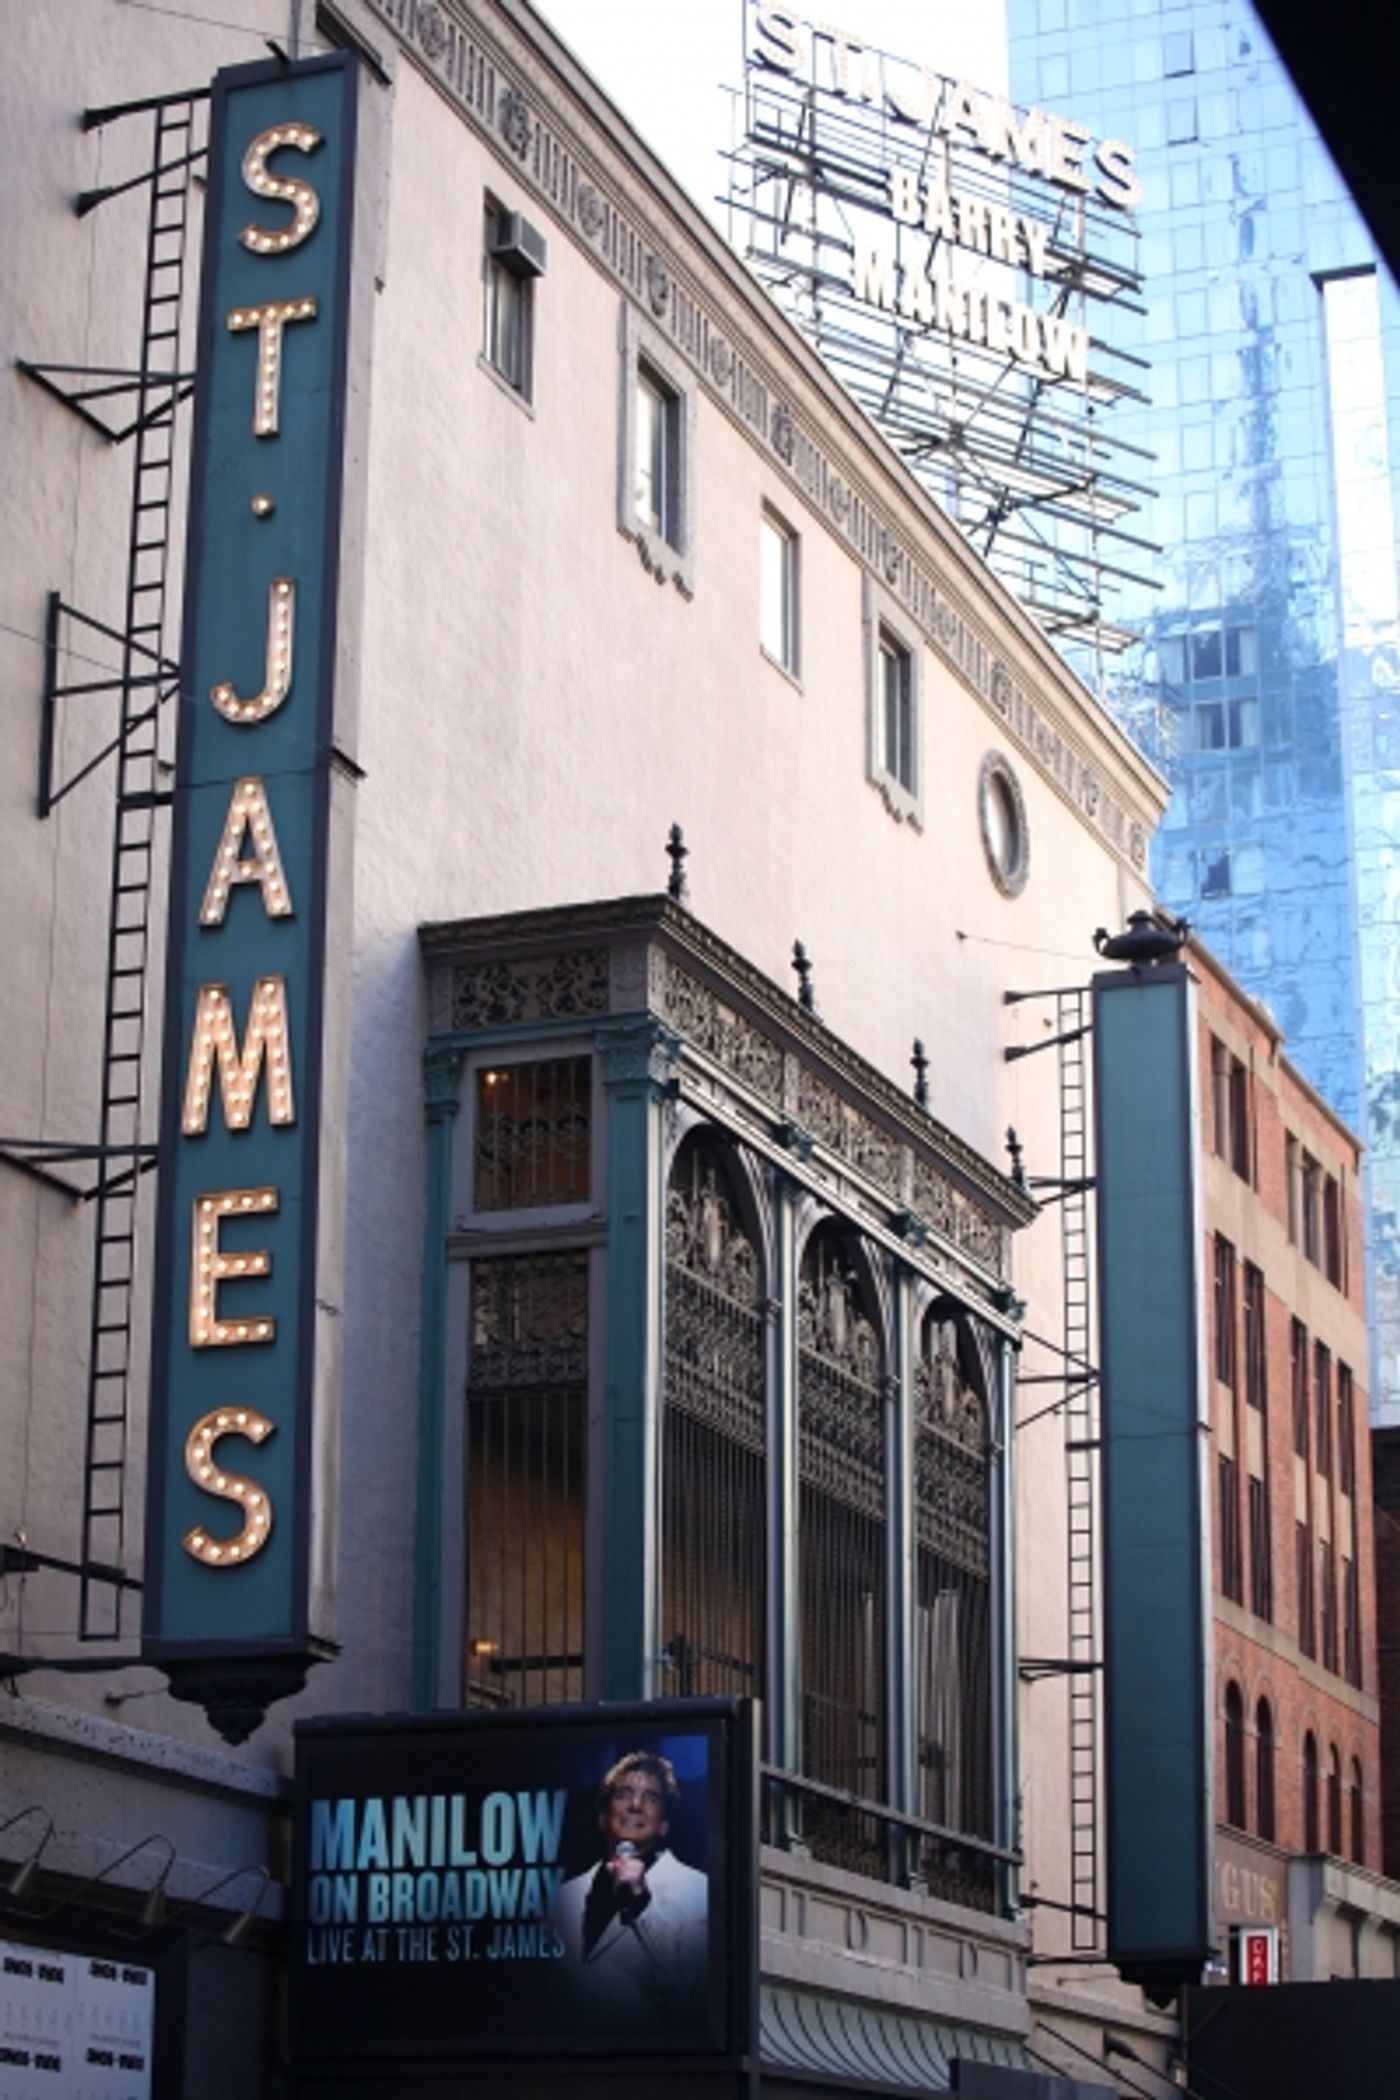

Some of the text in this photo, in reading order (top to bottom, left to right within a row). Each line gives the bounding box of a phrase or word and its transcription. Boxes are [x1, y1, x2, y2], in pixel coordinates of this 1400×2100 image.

[883, 64, 1143, 214] JAMES
[889, 168, 1048, 277] BARRY
[853, 240, 1089, 383] MANILOW
[180, 577, 298, 1567] JAMES
[309, 1789, 568, 1870] MANILOW
[307, 1922, 566, 1966] LIVE AT THE ST. JAMES
[308, 1866, 566, 1925] ON BROADWAY
